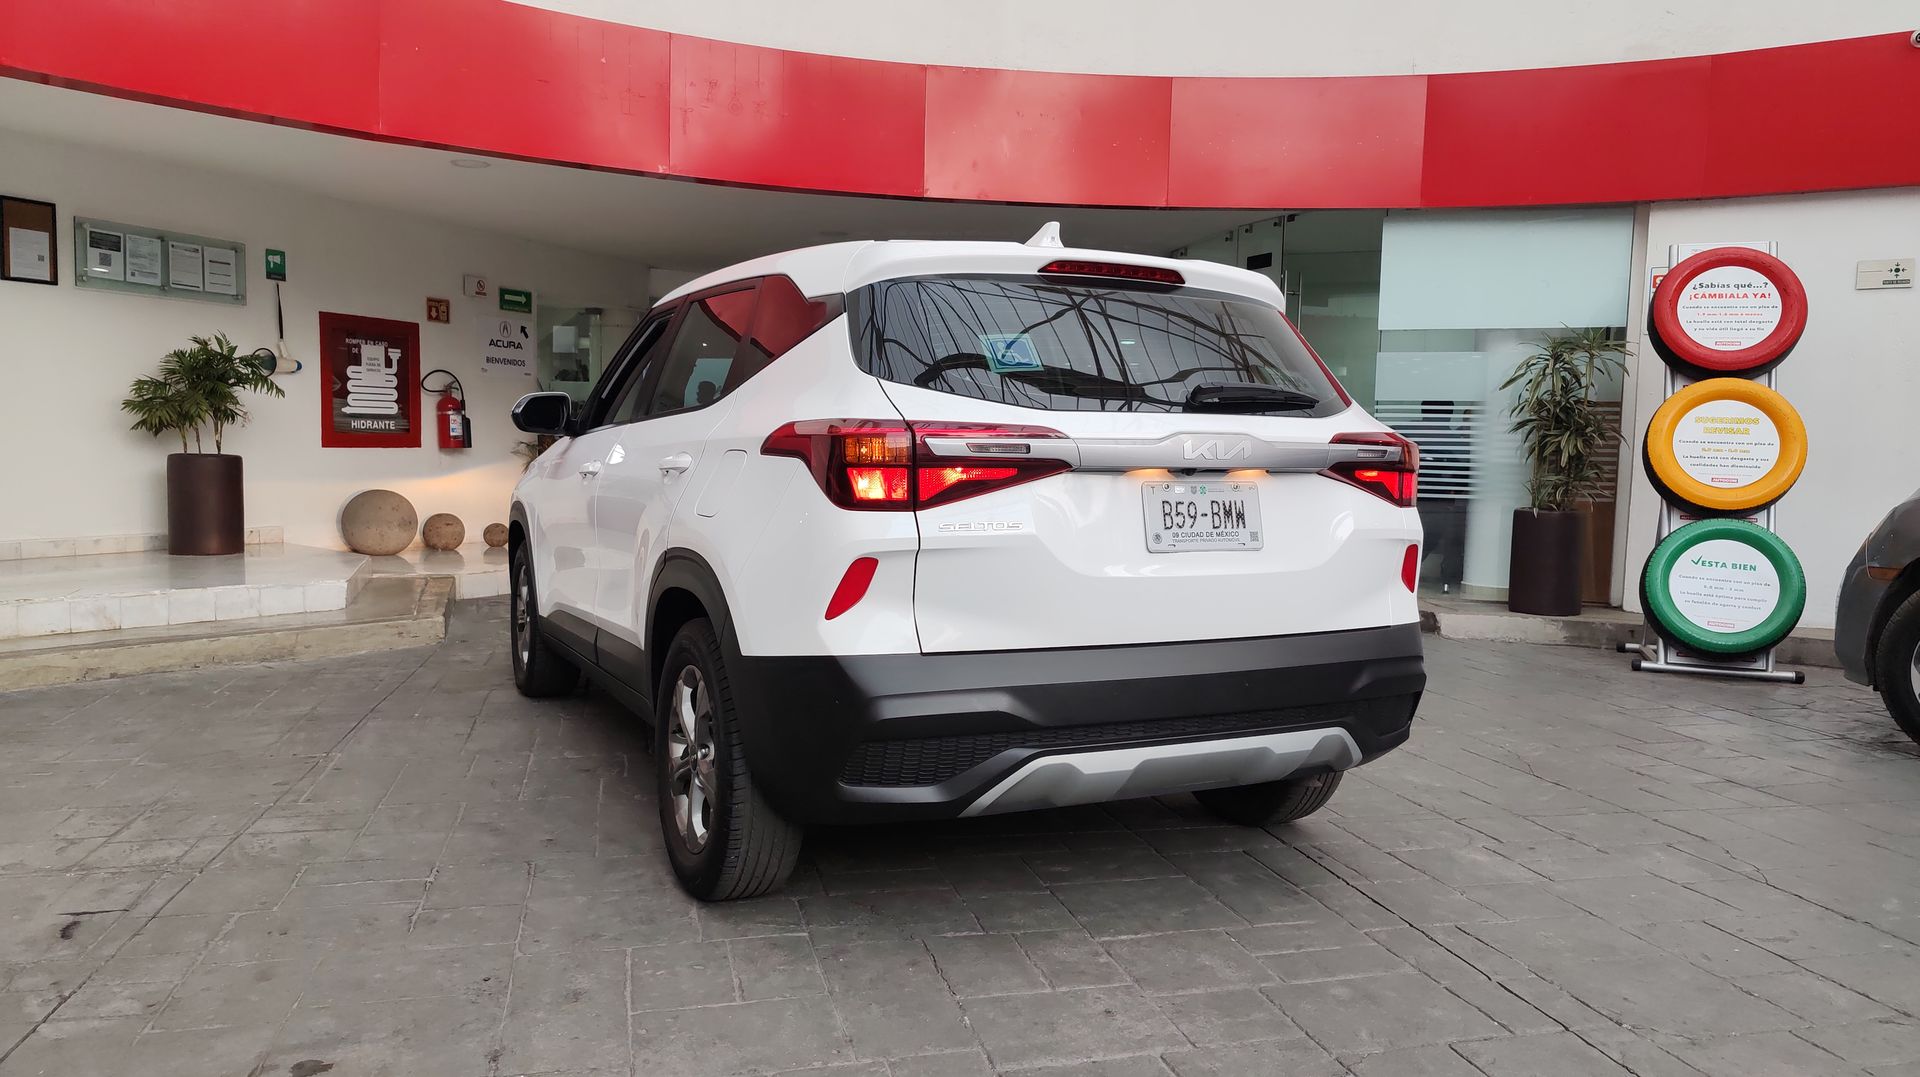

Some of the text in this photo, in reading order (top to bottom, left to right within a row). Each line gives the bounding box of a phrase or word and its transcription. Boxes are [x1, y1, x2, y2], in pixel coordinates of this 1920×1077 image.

[1734, 282, 1768, 290] qué...?
[489, 339, 523, 350] ACURA
[486, 356, 526, 367] BIENVENIDOS
[351, 420, 396, 429] HIDRANTE
[1695, 417, 1760, 425] SUGERIMOS
[1703, 426, 1750, 434] REVISAR
[1183, 440, 1252, 460] KIA
[1162, 500, 1246, 530] B59-BMW
[938, 522, 1023, 532] SELTOS
[1732, 563, 1756, 571] BIEN
